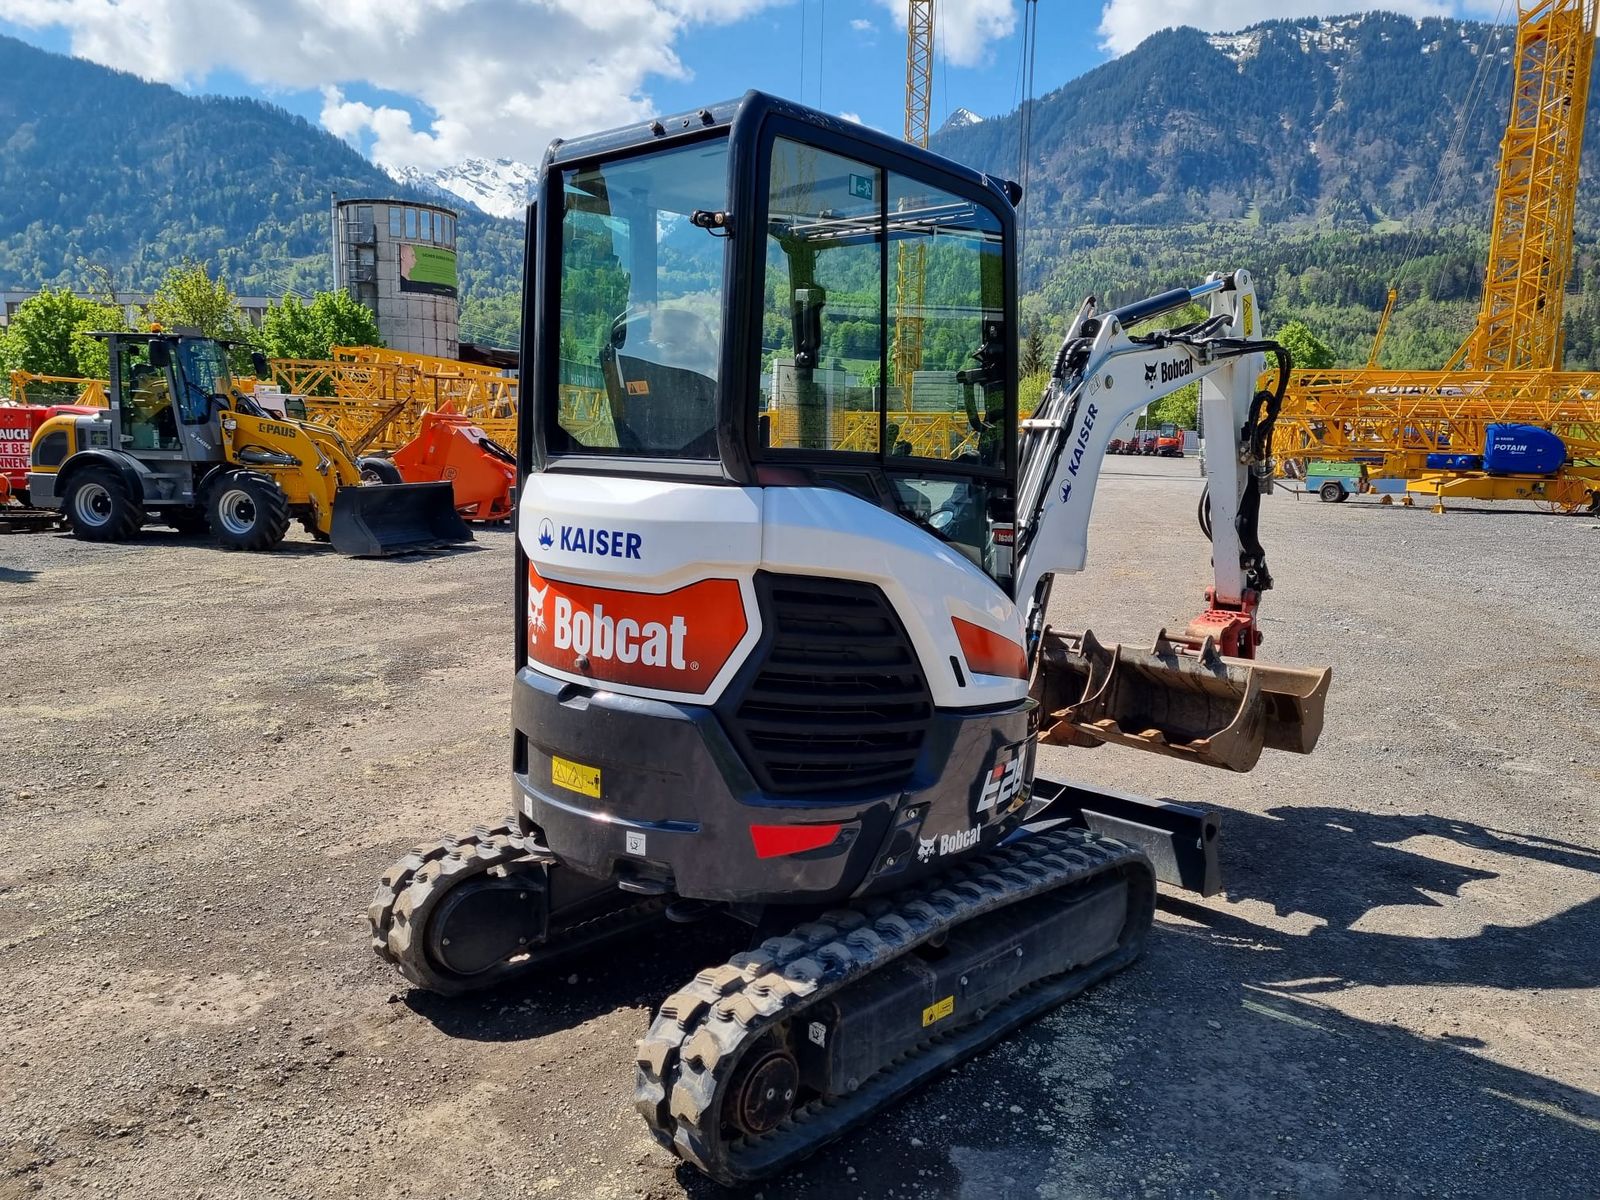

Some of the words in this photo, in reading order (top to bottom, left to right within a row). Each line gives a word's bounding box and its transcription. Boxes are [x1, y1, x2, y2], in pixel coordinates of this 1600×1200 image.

[1161, 357, 1193, 383] Bobcat
[266, 424, 297, 438] PAUS
[1068, 403, 1098, 477] KAISER
[560, 525, 642, 560] KAISER
[554, 596, 687, 670] Bobcat
[939, 822, 981, 856] Bobcat
